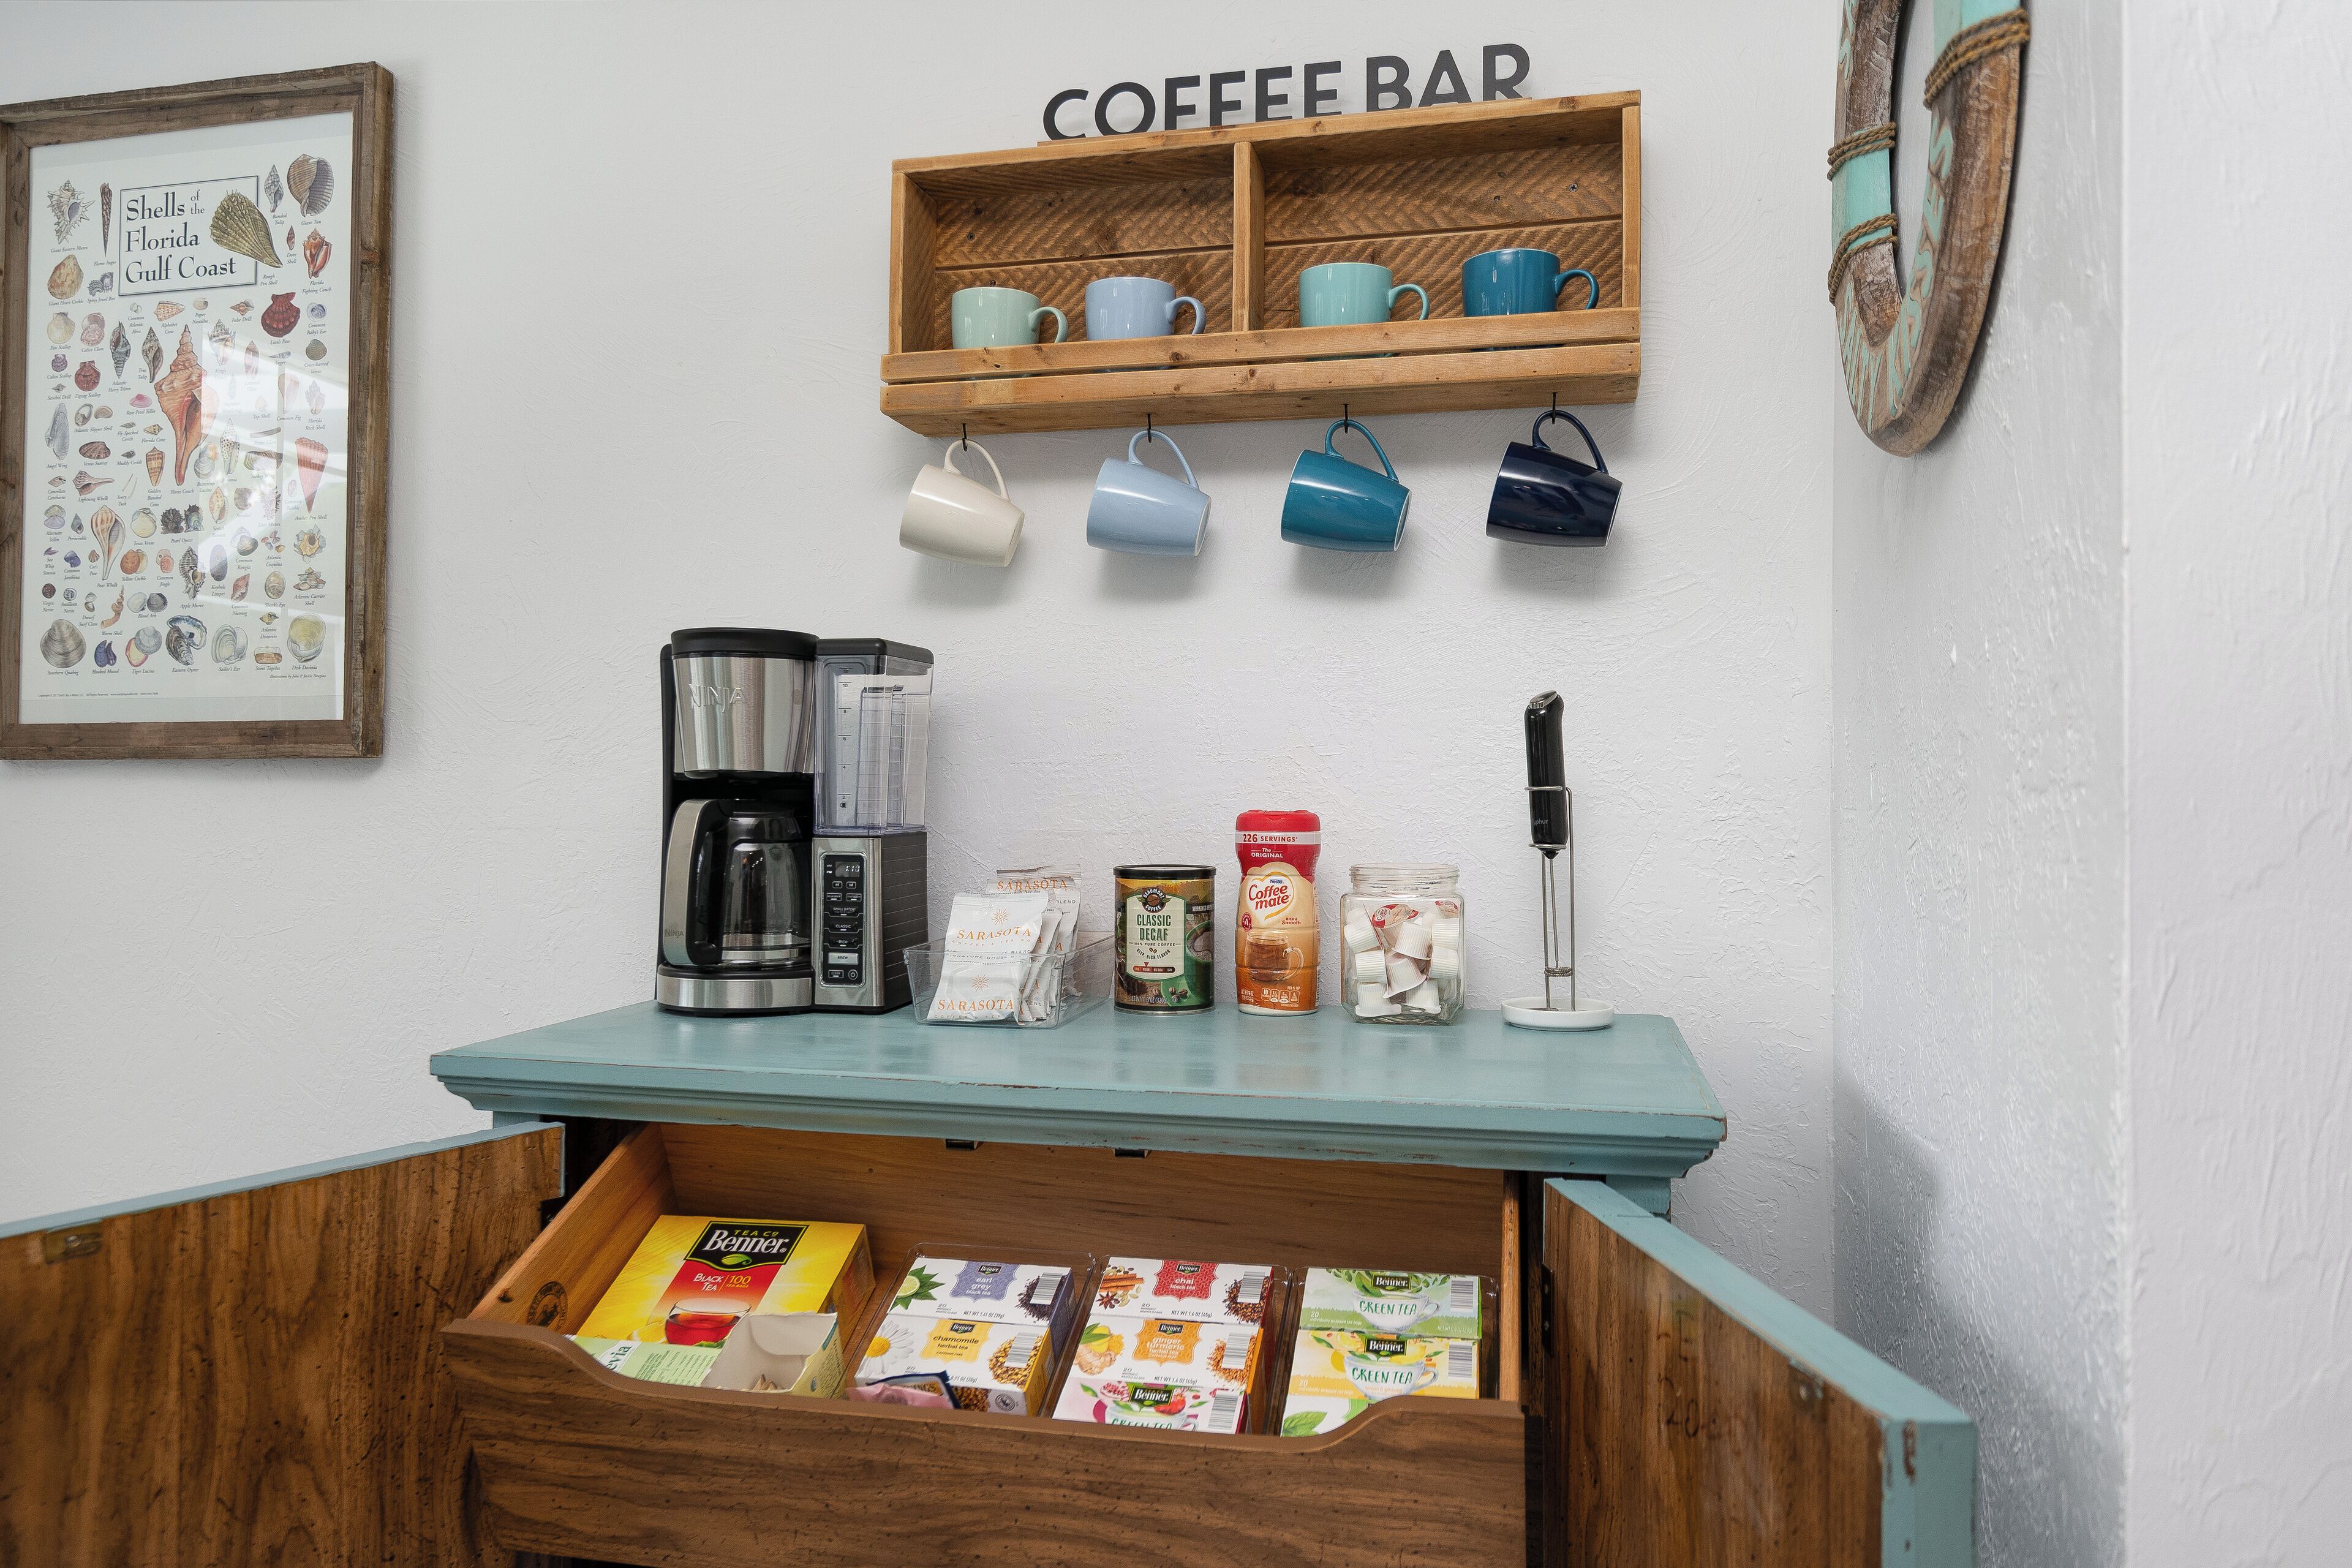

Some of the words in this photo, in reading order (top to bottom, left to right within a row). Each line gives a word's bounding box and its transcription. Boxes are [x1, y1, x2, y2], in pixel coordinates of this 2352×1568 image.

[1043, 61, 1341, 140] COFFEE
[1366, 43, 1531, 113] BAR
[190, 190, 200, 202] of
[126, 191, 185, 223] Shells
[190, 203, 205, 215] the
[124, 222, 200, 252] Florida
[125, 254, 172, 284] Gulf
[178, 255, 236, 279] Coast
[689, 684, 747, 712] NINJA
[1243, 833, 1257, 842] 226
[997, 880, 1067, 891] SARASOTA
[1143, 888, 1164, 899] BEAUMONT
[1249, 884, 1287, 900] Coffee
[1255, 894, 1291, 910] mate
[1137, 914, 1170, 926] CLASSIC
[665, 929, 684, 938] NINJA
[957, 926, 1031, 940] SARASOTA
[1139, 928, 1169, 941] DECAF
[1136, 949, 1145, 958] DEEP,
[1157, 949, 1170, 959] FLAVOR
[938, 1000, 1013, 1011] SARASOTA
[729, 1275, 751, 1284] 100
[1376, 1276, 1409, 1287] Benner
[1360, 1300, 1394, 1314] GREEN
[1399, 1303, 1417, 1314] TEA
[1370, 1340, 1403, 1352] Benner
[1352, 1368, 1389, 1383] GREEN
[1393, 1372, 1412, 1384] TEA
[1134, 1389, 1169, 1401] Benner
